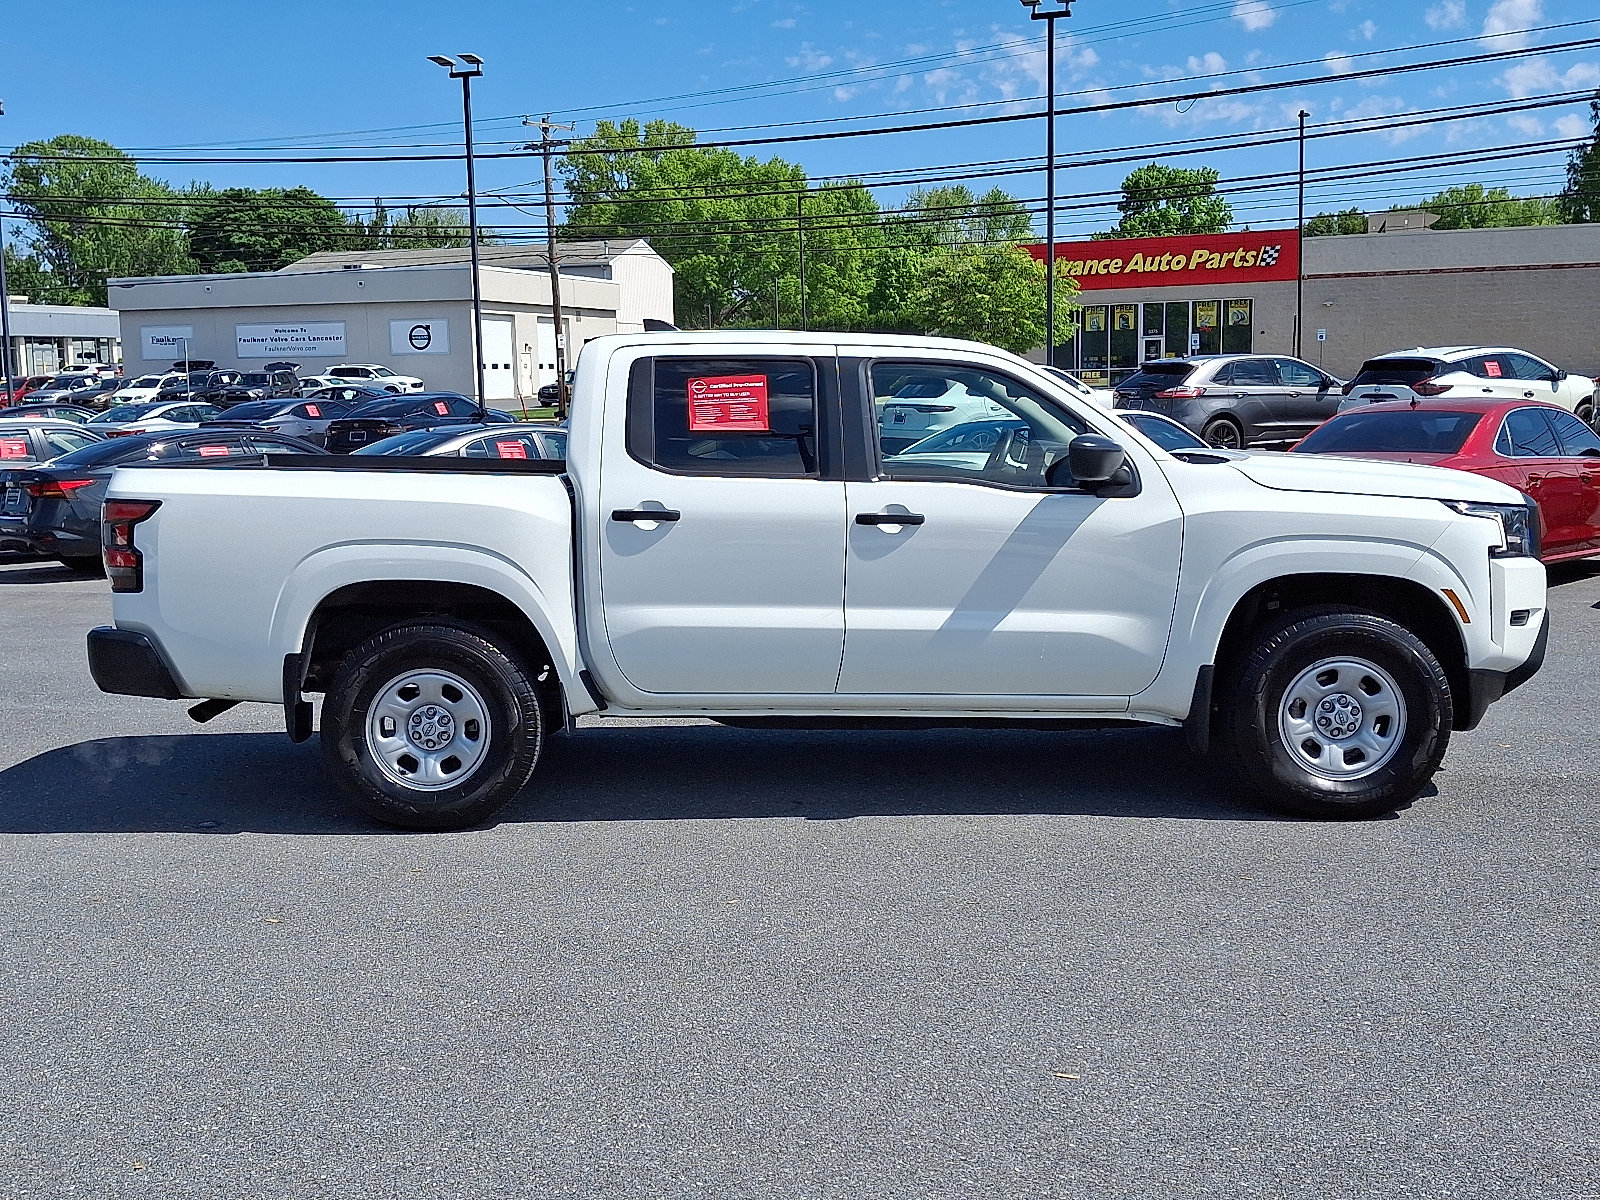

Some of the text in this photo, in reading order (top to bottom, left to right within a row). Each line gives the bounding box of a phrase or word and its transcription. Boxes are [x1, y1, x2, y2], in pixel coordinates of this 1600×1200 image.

[1123, 252, 1186, 274] Auto
[1188, 247, 1258, 270] Parts
[1081, 371, 1101, 379] FREE
